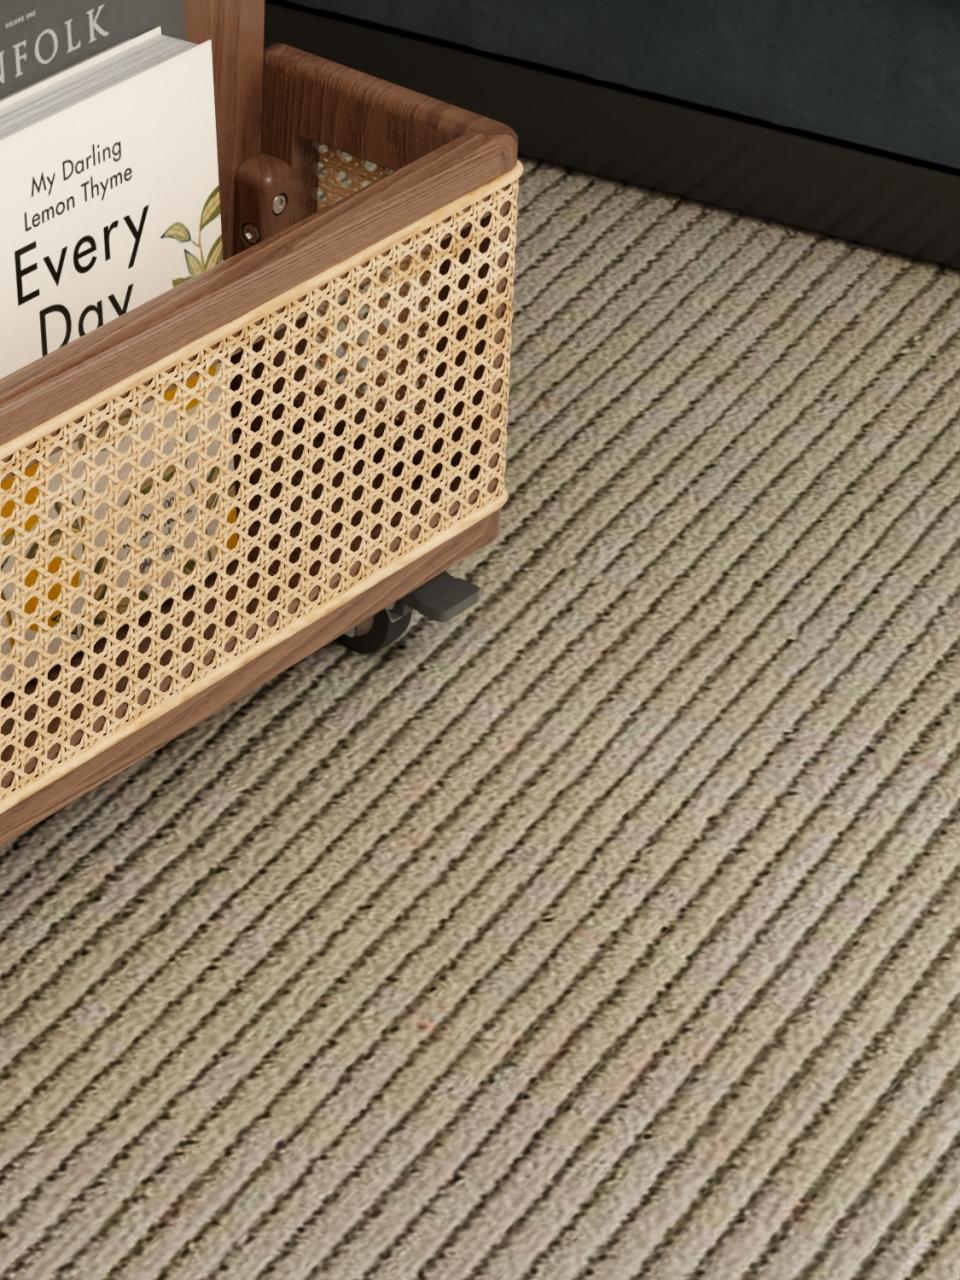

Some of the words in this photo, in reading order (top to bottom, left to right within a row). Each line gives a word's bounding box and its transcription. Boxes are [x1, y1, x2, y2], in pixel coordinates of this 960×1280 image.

[24, 195, 76, 232] Lemon
[80, 166, 134, 202] Thyme
[30, 172, 57, 198] My
[62, 140, 122, 181] Darling
[14, 205, 150, 306] Every
